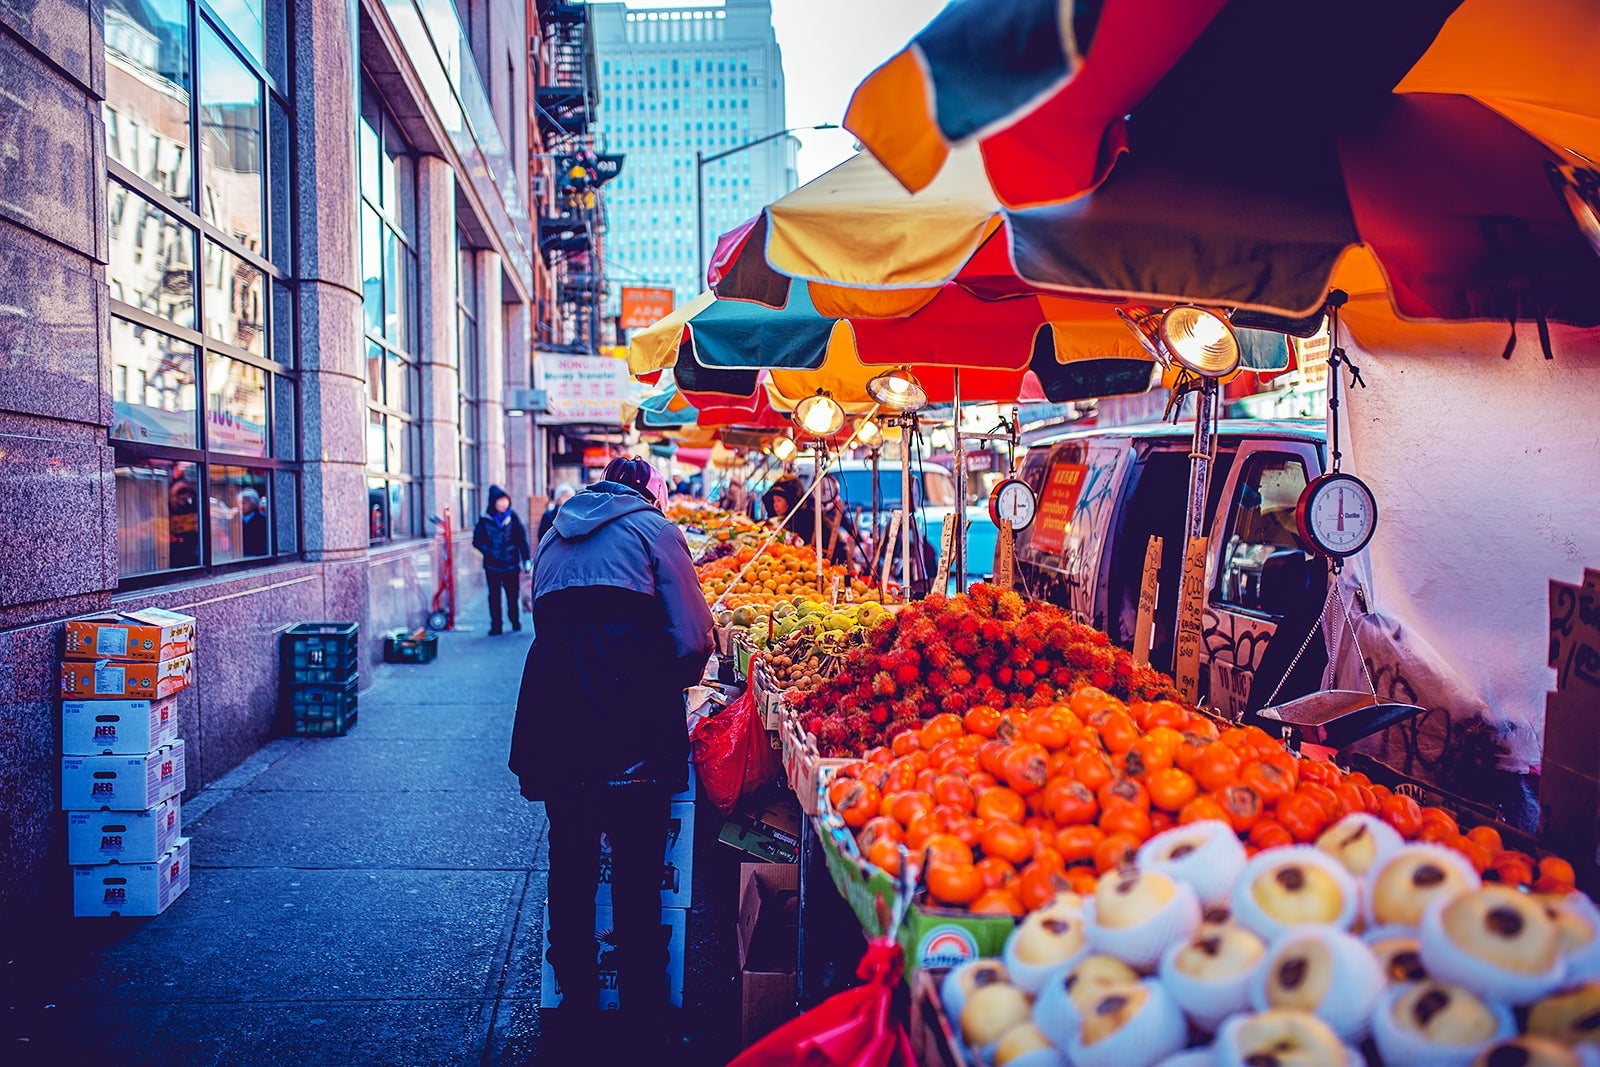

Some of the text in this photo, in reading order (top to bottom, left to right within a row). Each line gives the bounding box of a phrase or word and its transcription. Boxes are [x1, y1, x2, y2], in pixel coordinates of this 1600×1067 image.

[544, 372, 574, 380] Money
[95, 726, 116, 737] AEG
[93, 783, 113, 794] AEG
[101, 836, 122, 848] AEG
[104, 888, 125, 901] AEG
